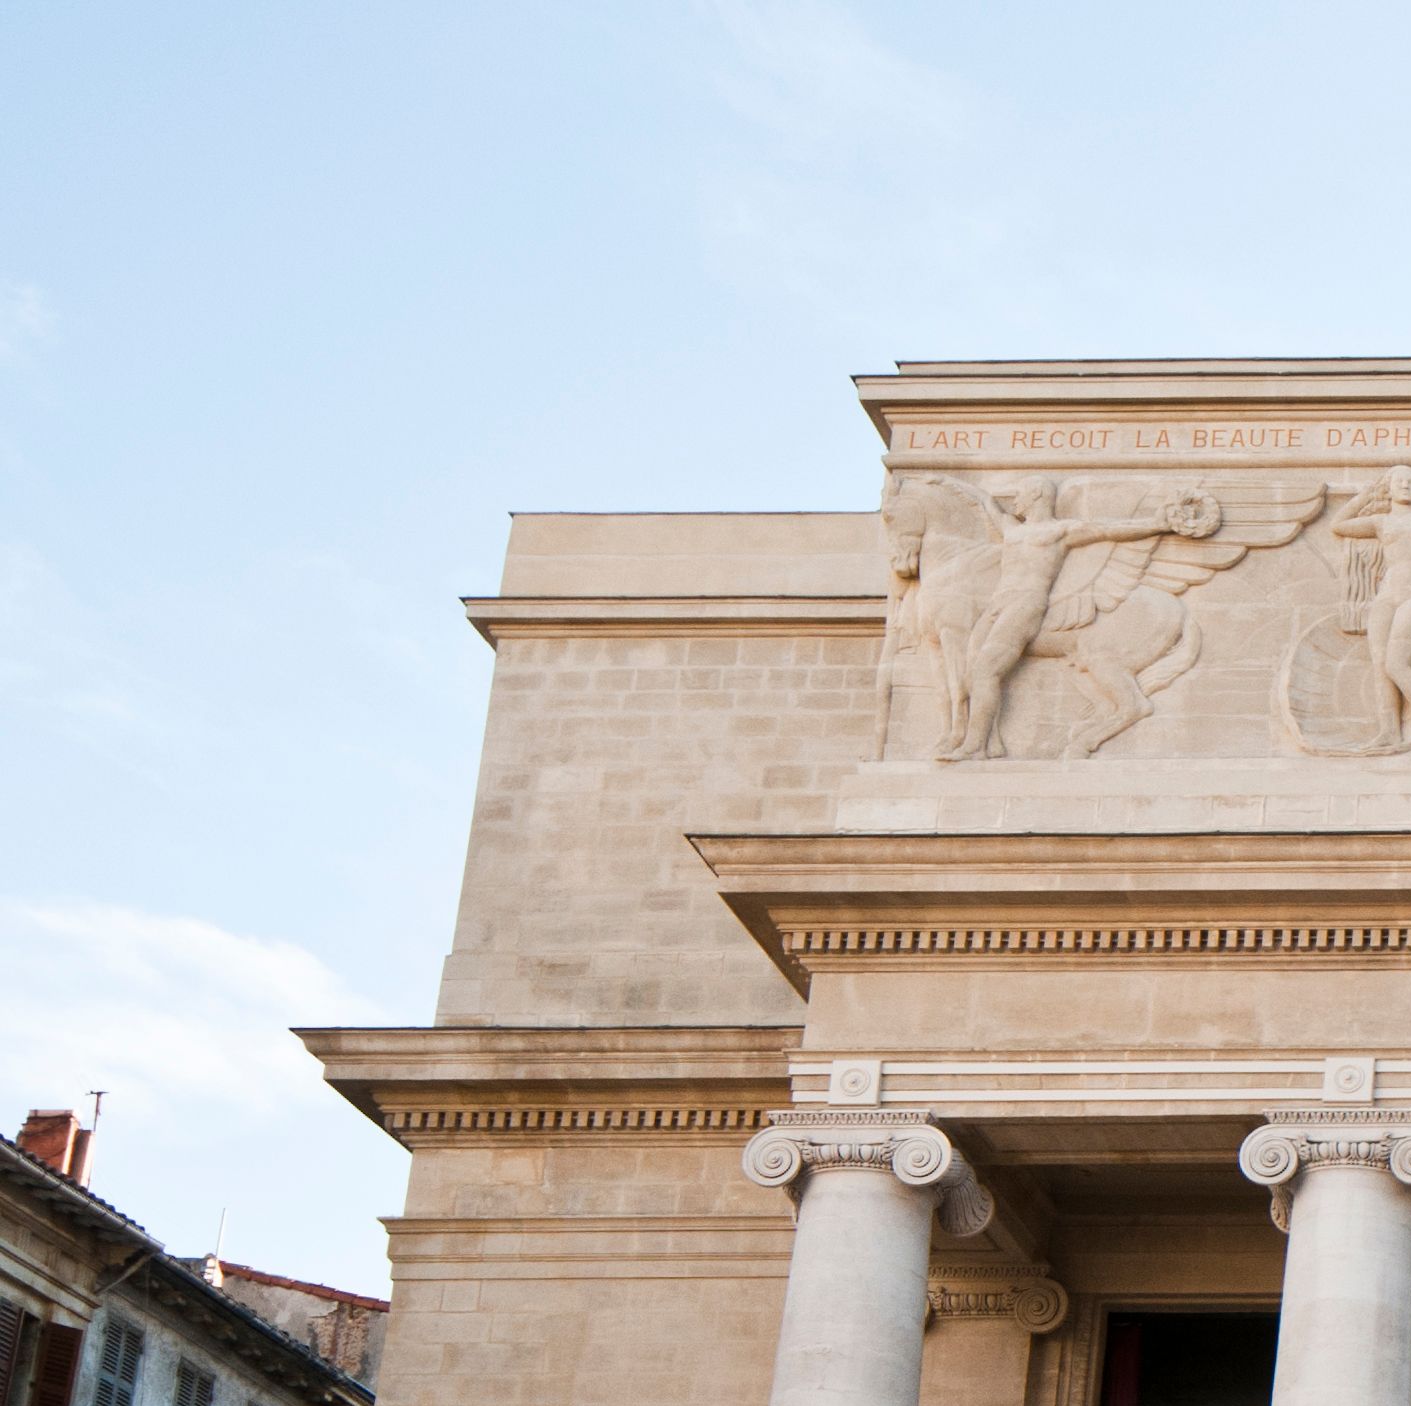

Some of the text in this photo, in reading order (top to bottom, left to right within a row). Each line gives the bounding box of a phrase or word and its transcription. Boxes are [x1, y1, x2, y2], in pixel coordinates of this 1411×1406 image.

[908, 430, 990, 449] L'ART
[1010, 429, 1114, 449] RECOIT
[1135, 429, 1171, 448] LA
[1192, 428, 1304, 448] BEAUTE
